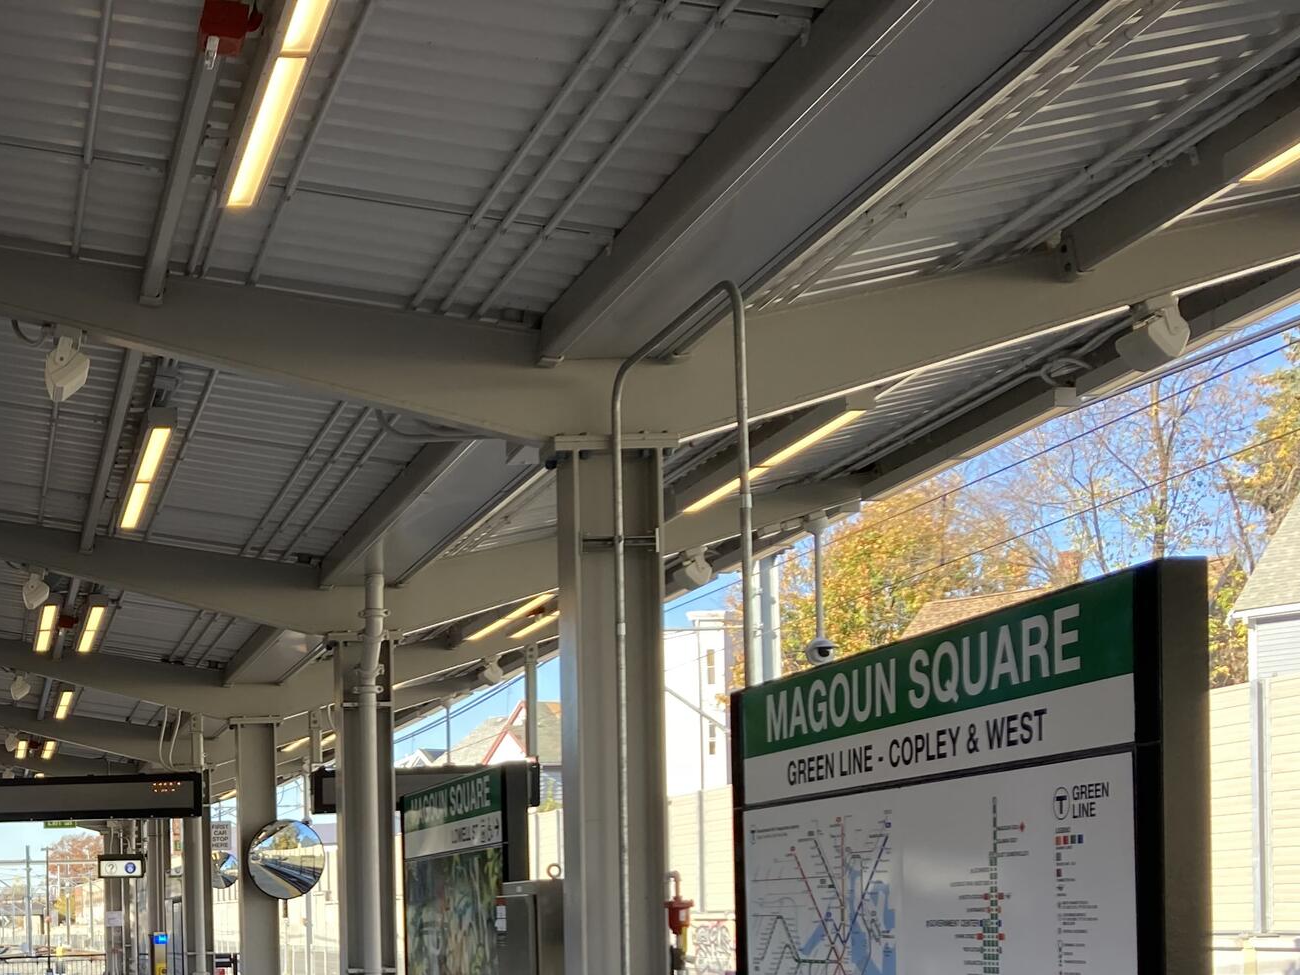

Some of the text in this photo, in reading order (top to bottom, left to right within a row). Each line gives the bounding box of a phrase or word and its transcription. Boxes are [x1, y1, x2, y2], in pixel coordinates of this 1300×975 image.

[766, 603, 1081, 743] MAGOUN SQUARE
[787, 756, 835, 786] GREEN
[840, 744, 873, 776] LINE
[889, 727, 960, 768] COPLEY
[968, 723, 979, 754] &
[987, 708, 1047, 750] WEST
[449, 775, 491, 817] SQUARE
[1072, 781, 1109, 801] GREEN
[1072, 801, 1096, 819] LINE
